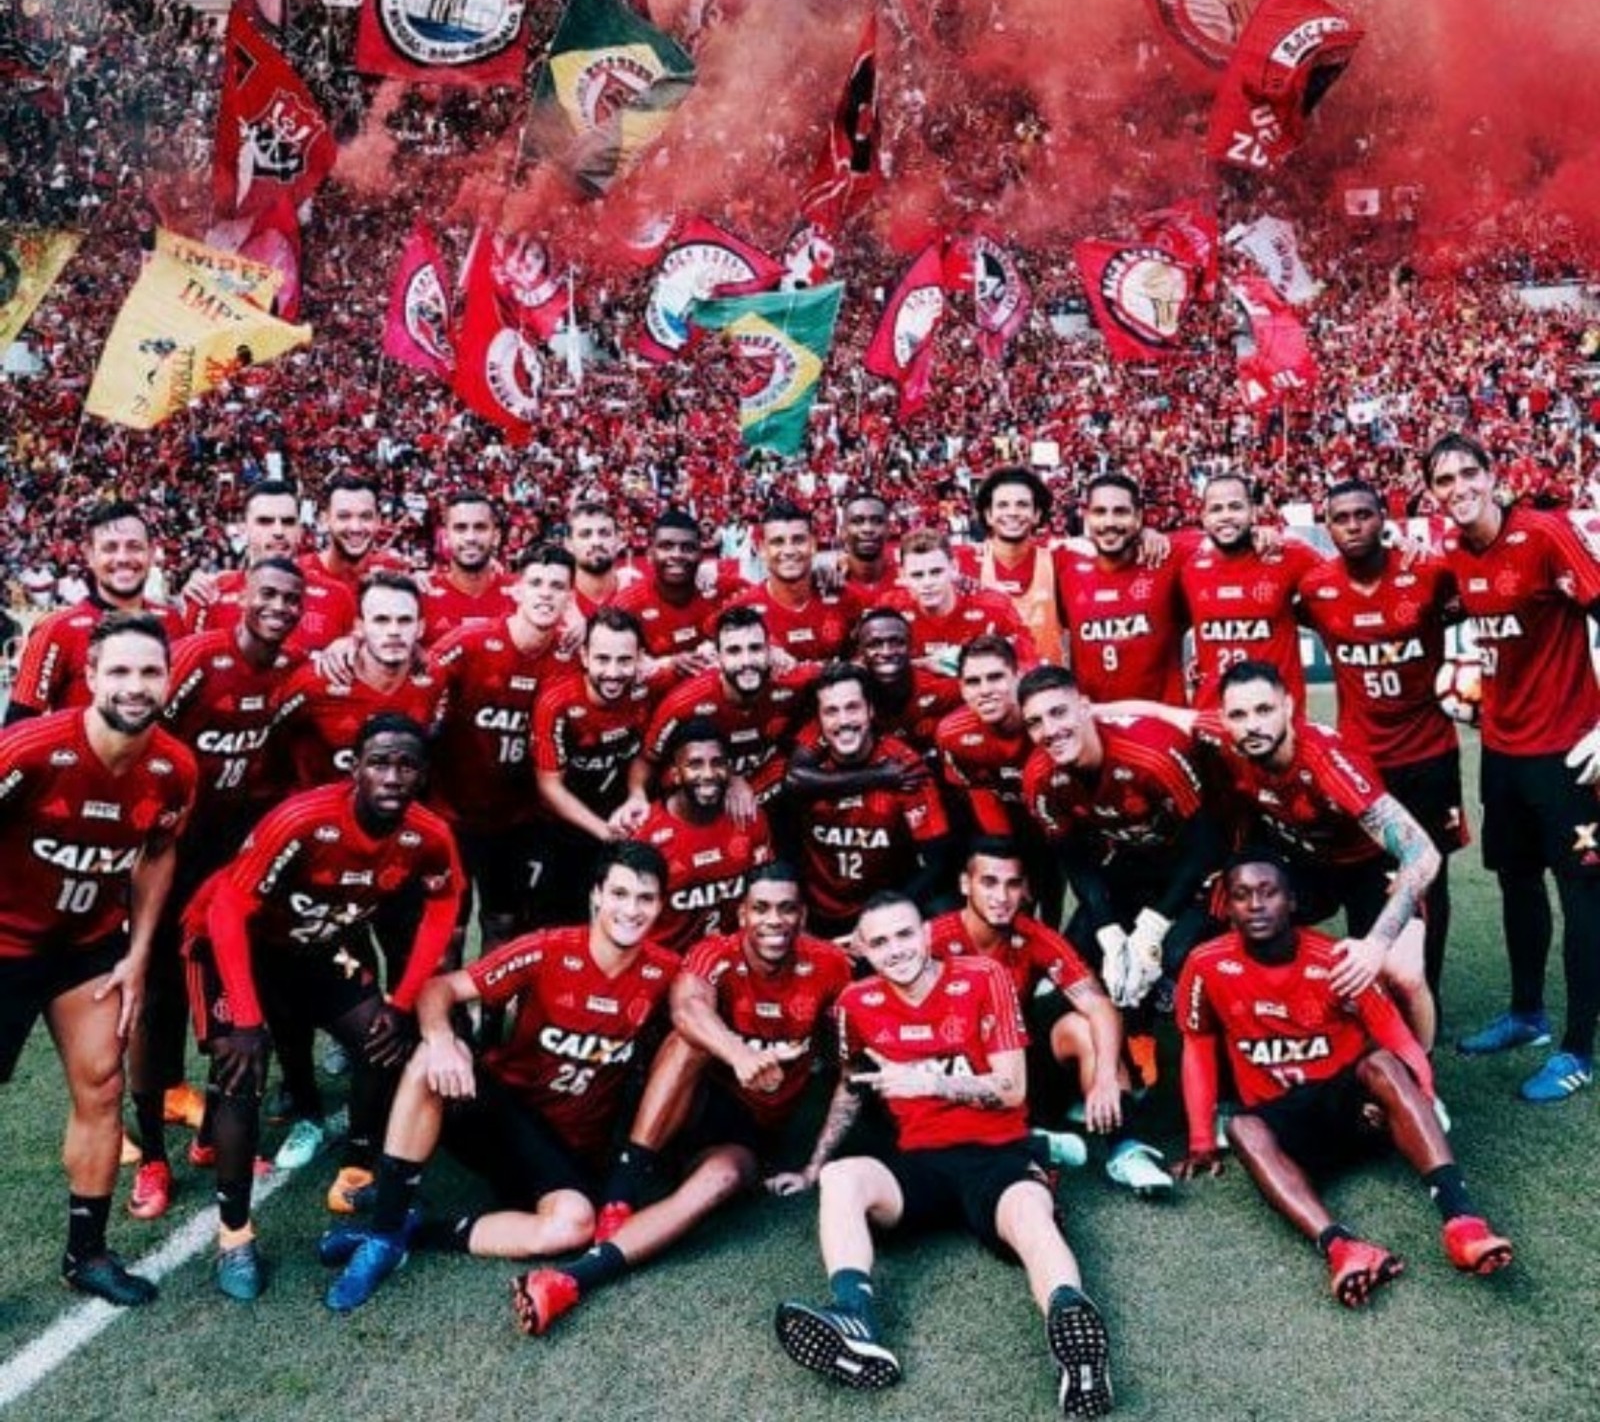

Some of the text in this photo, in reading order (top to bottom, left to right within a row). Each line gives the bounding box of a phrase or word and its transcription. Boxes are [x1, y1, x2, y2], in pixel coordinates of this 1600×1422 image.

[1081, 614, 1150, 641] CAIXA
[1202, 620, 1271, 640] CAIXA
[1103, 644, 1118, 671] 9
[1336, 638, 1424, 666] CAIXA
[1363, 670, 1401, 698] 50
[498, 736, 526, 763] 16
[813, 825, 891, 849] CAIXA
[528, 861, 543, 888] 7
[837, 851, 863, 880] 12
[56, 878, 99, 913] 10
[539, 1026, 634, 1065] CAIXA
[549, 1063, 596, 1096] 26
